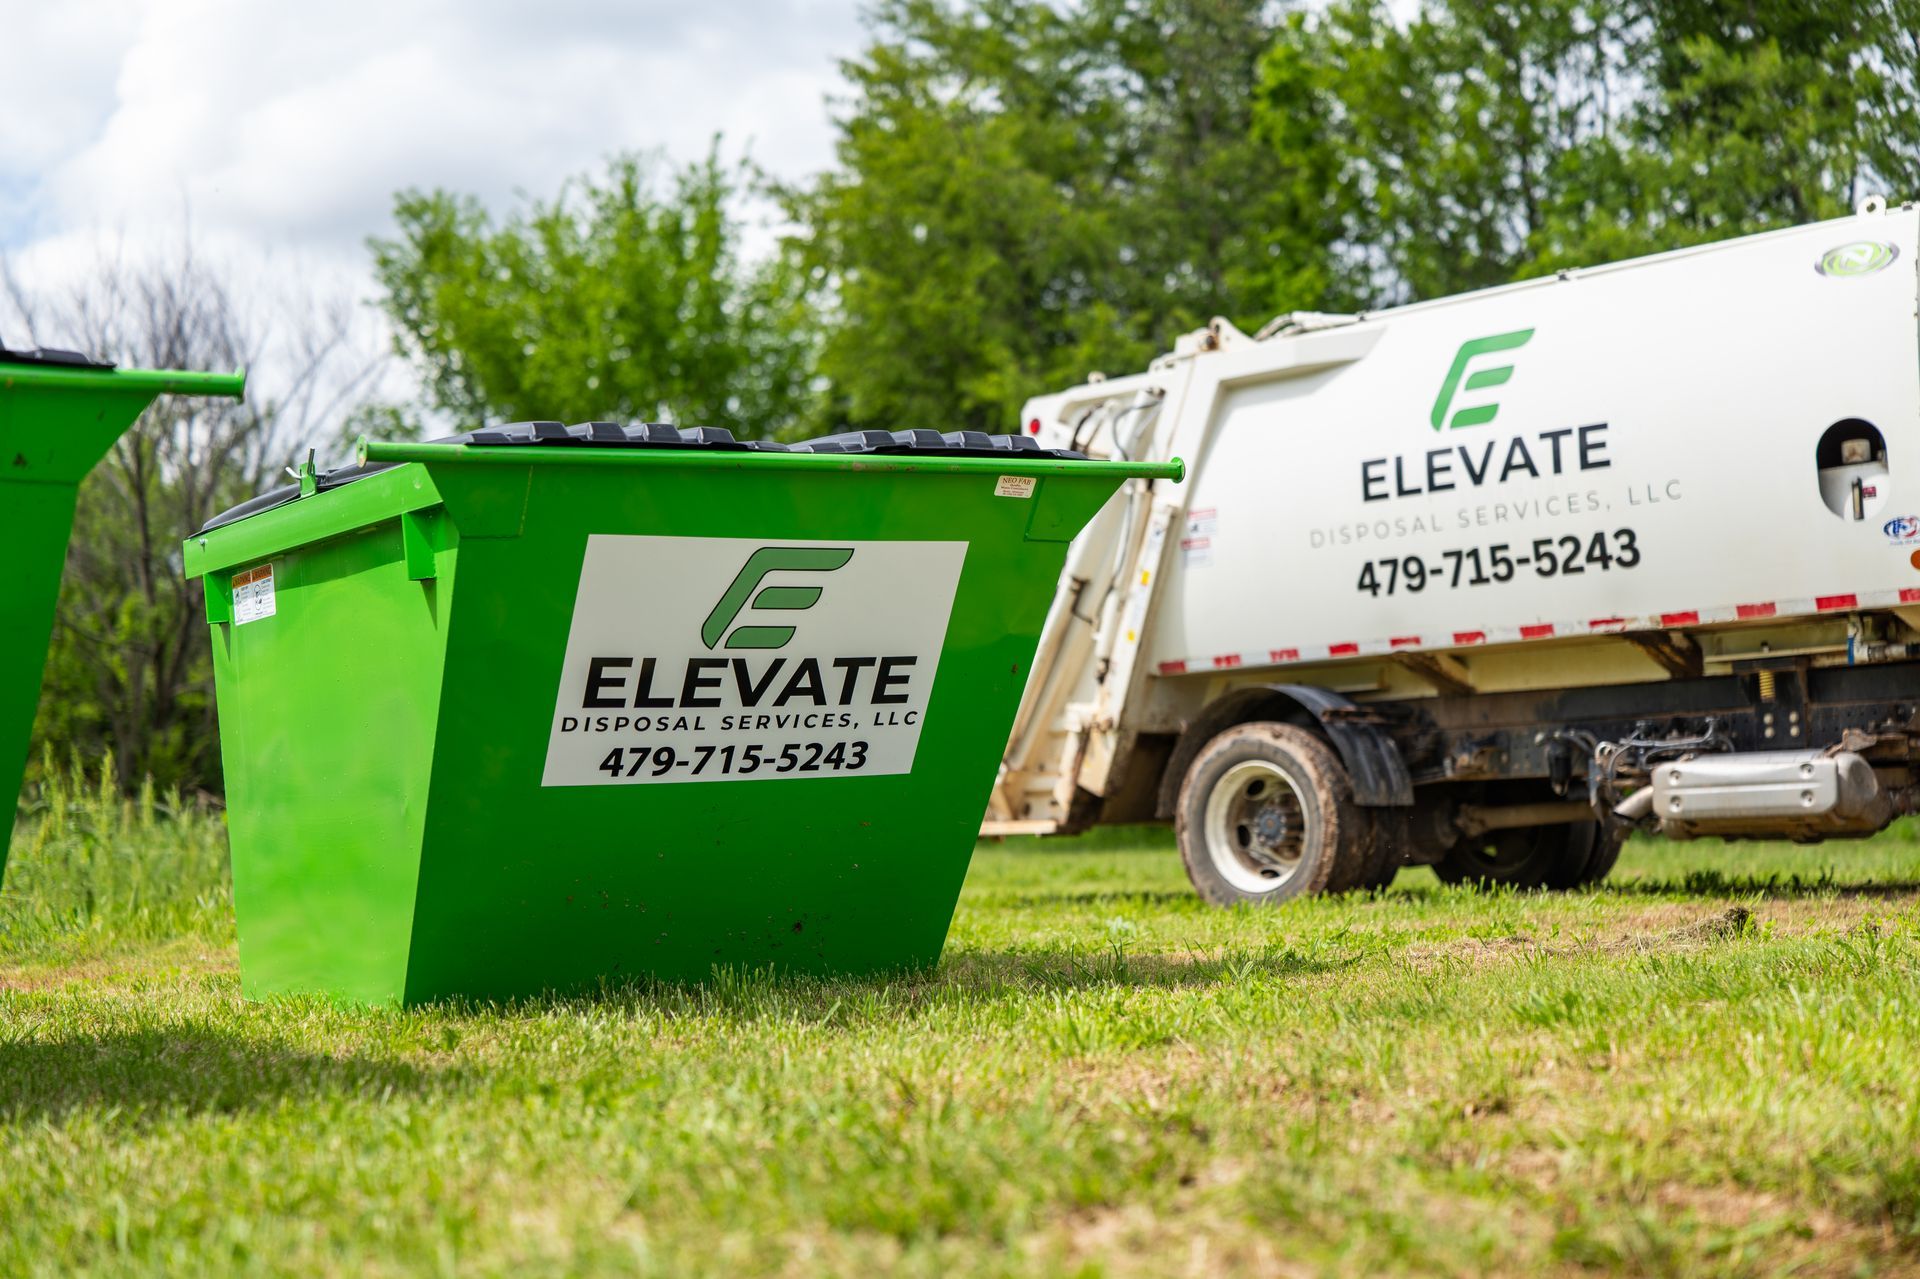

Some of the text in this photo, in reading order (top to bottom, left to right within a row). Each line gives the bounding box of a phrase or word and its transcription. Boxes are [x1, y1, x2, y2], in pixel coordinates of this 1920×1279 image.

[1361, 422, 1611, 502] ELEVATE
[1310, 478, 1683, 549] DISPOSAL SERVICES, LLC
[1357, 528, 1641, 598] 479-715-5243
[582, 655, 918, 709] ELEVATE
[560, 710, 918, 733] DISPOSAL SERVICES, LLC
[598, 740, 869, 778] 479-715-5243
